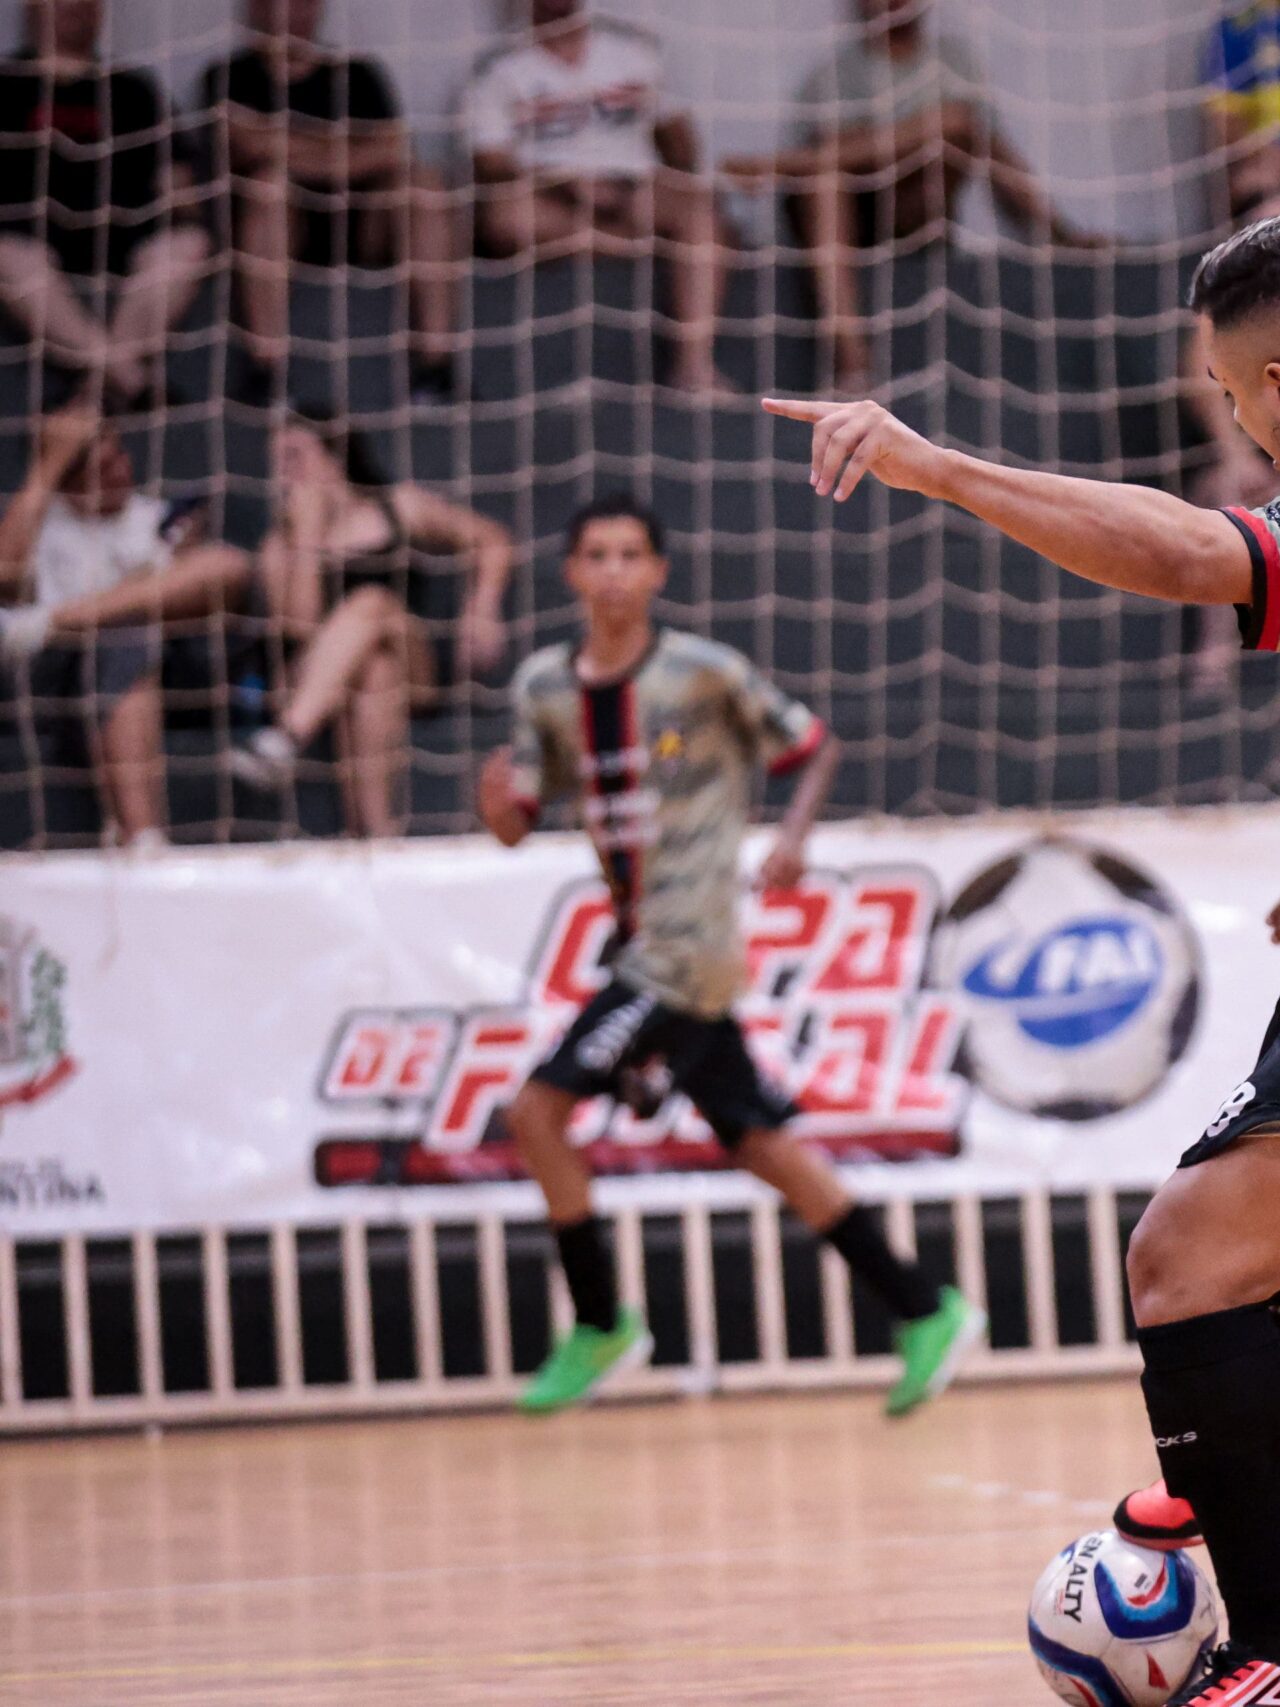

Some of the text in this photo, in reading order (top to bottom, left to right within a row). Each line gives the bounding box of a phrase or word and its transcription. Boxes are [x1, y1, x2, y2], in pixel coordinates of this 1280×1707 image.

[1035, 924, 1155, 993] FAI
[1156, 1431, 1198, 1448] CKS
[1063, 1536, 1103, 1624] ENALTY
